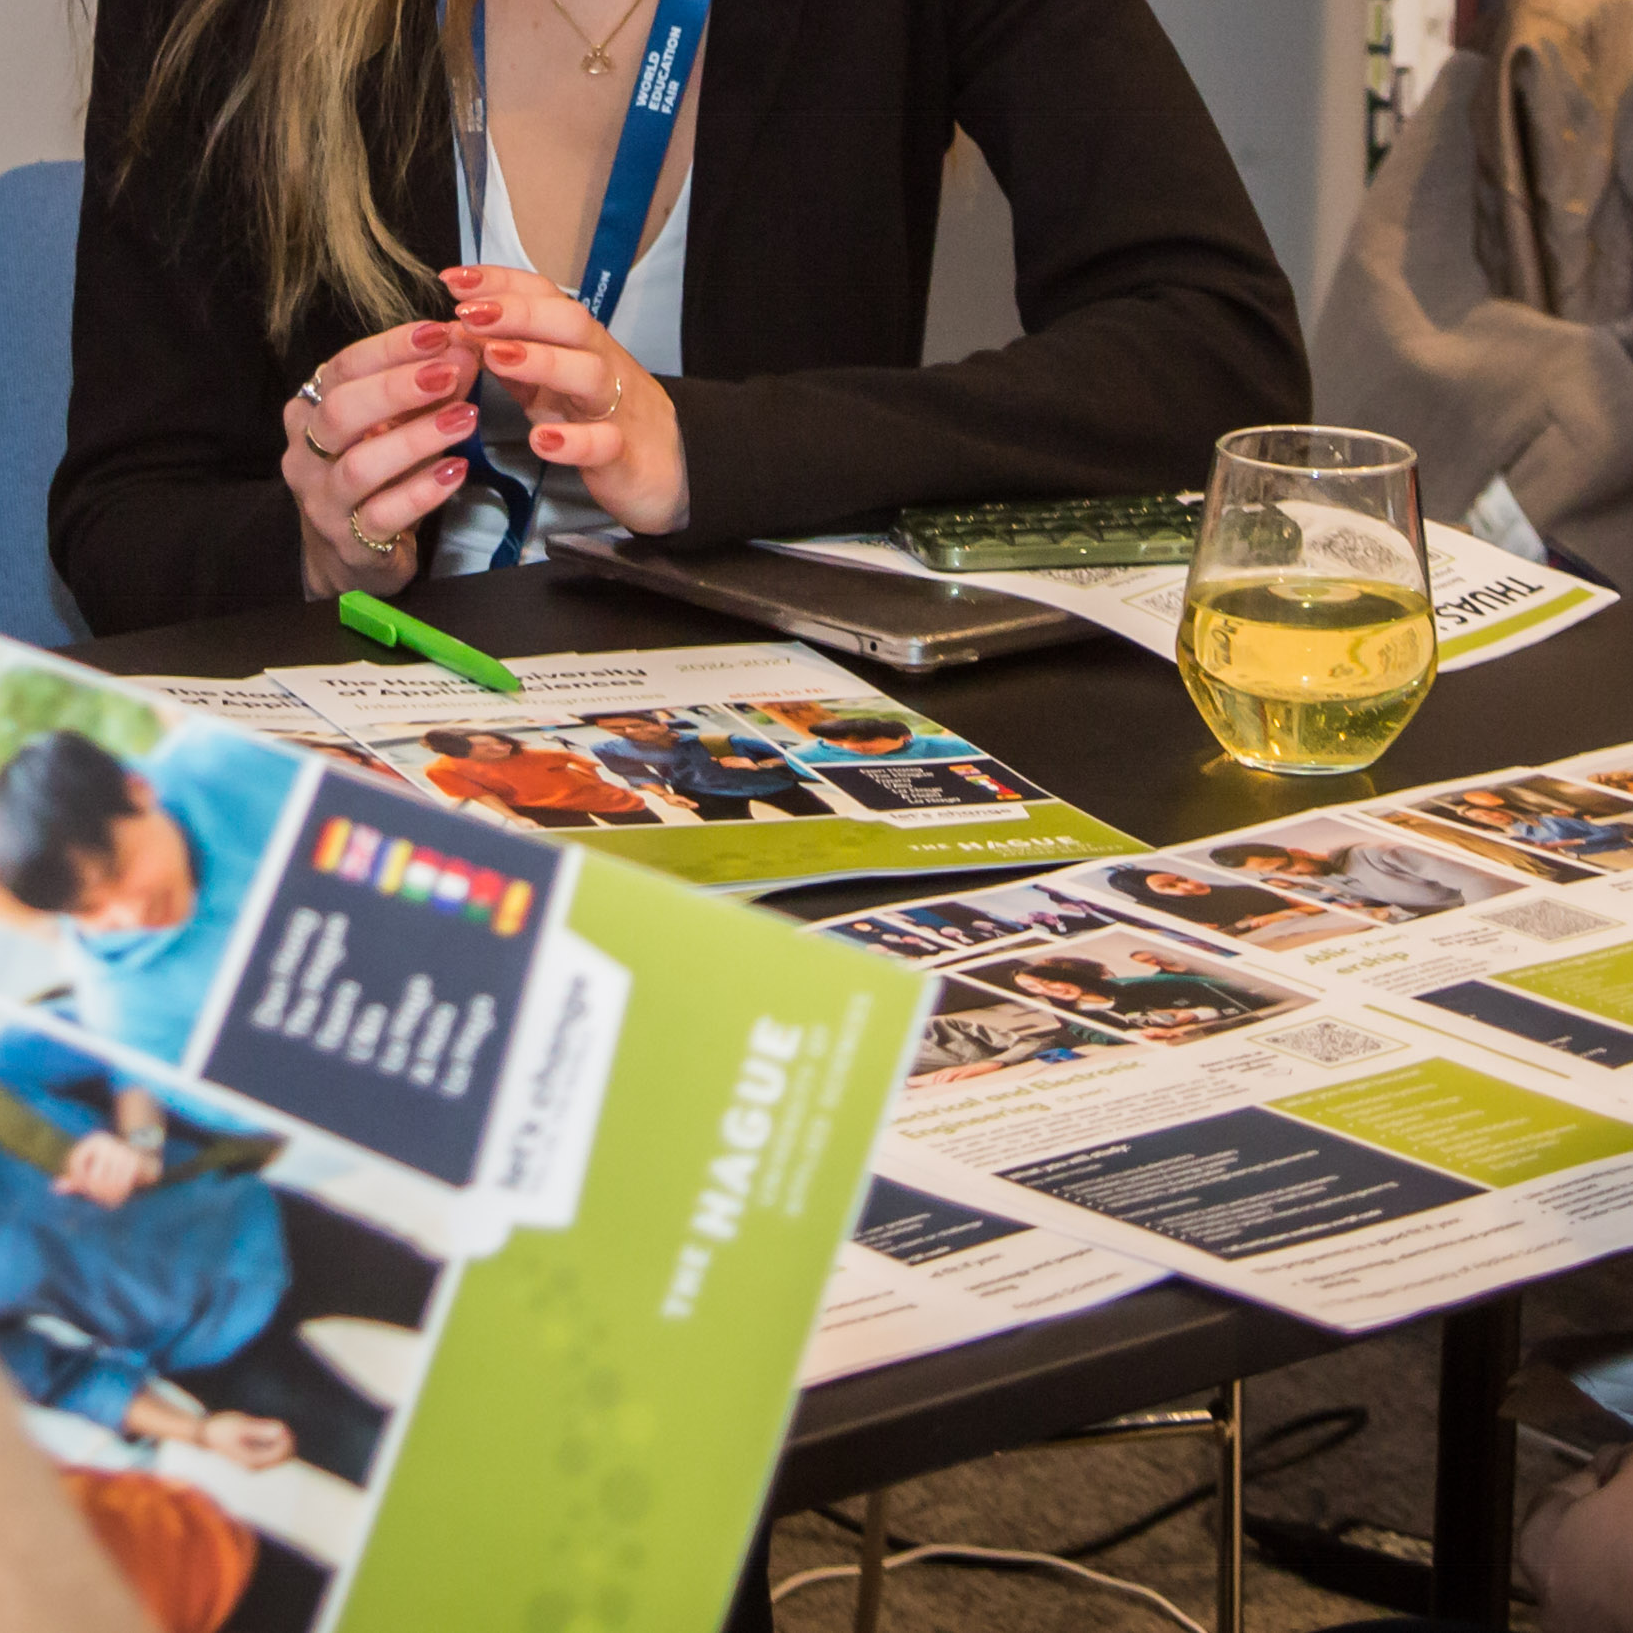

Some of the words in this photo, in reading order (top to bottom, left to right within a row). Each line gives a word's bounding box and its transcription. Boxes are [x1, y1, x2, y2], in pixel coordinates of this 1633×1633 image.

[635, 50, 661, 107] WORLD
[648, 25, 682, 112] EDUCATION
[661, 79, 680, 115] FAIR
[1434, 576, 1545, 627] THUAS
[223, 689, 293, 703] Hag
[322, 678, 377, 689] The
[384, 677, 469, 691] Hagu
[516, 666, 648, 686] niversity
[519, 678, 646, 694] ciences
[908, 842, 951, 853] THE
[957, 834, 1080, 853] HAGUE
[658, 1239, 712, 1323] THE
[699, 1013, 807, 1243] HAGUE
